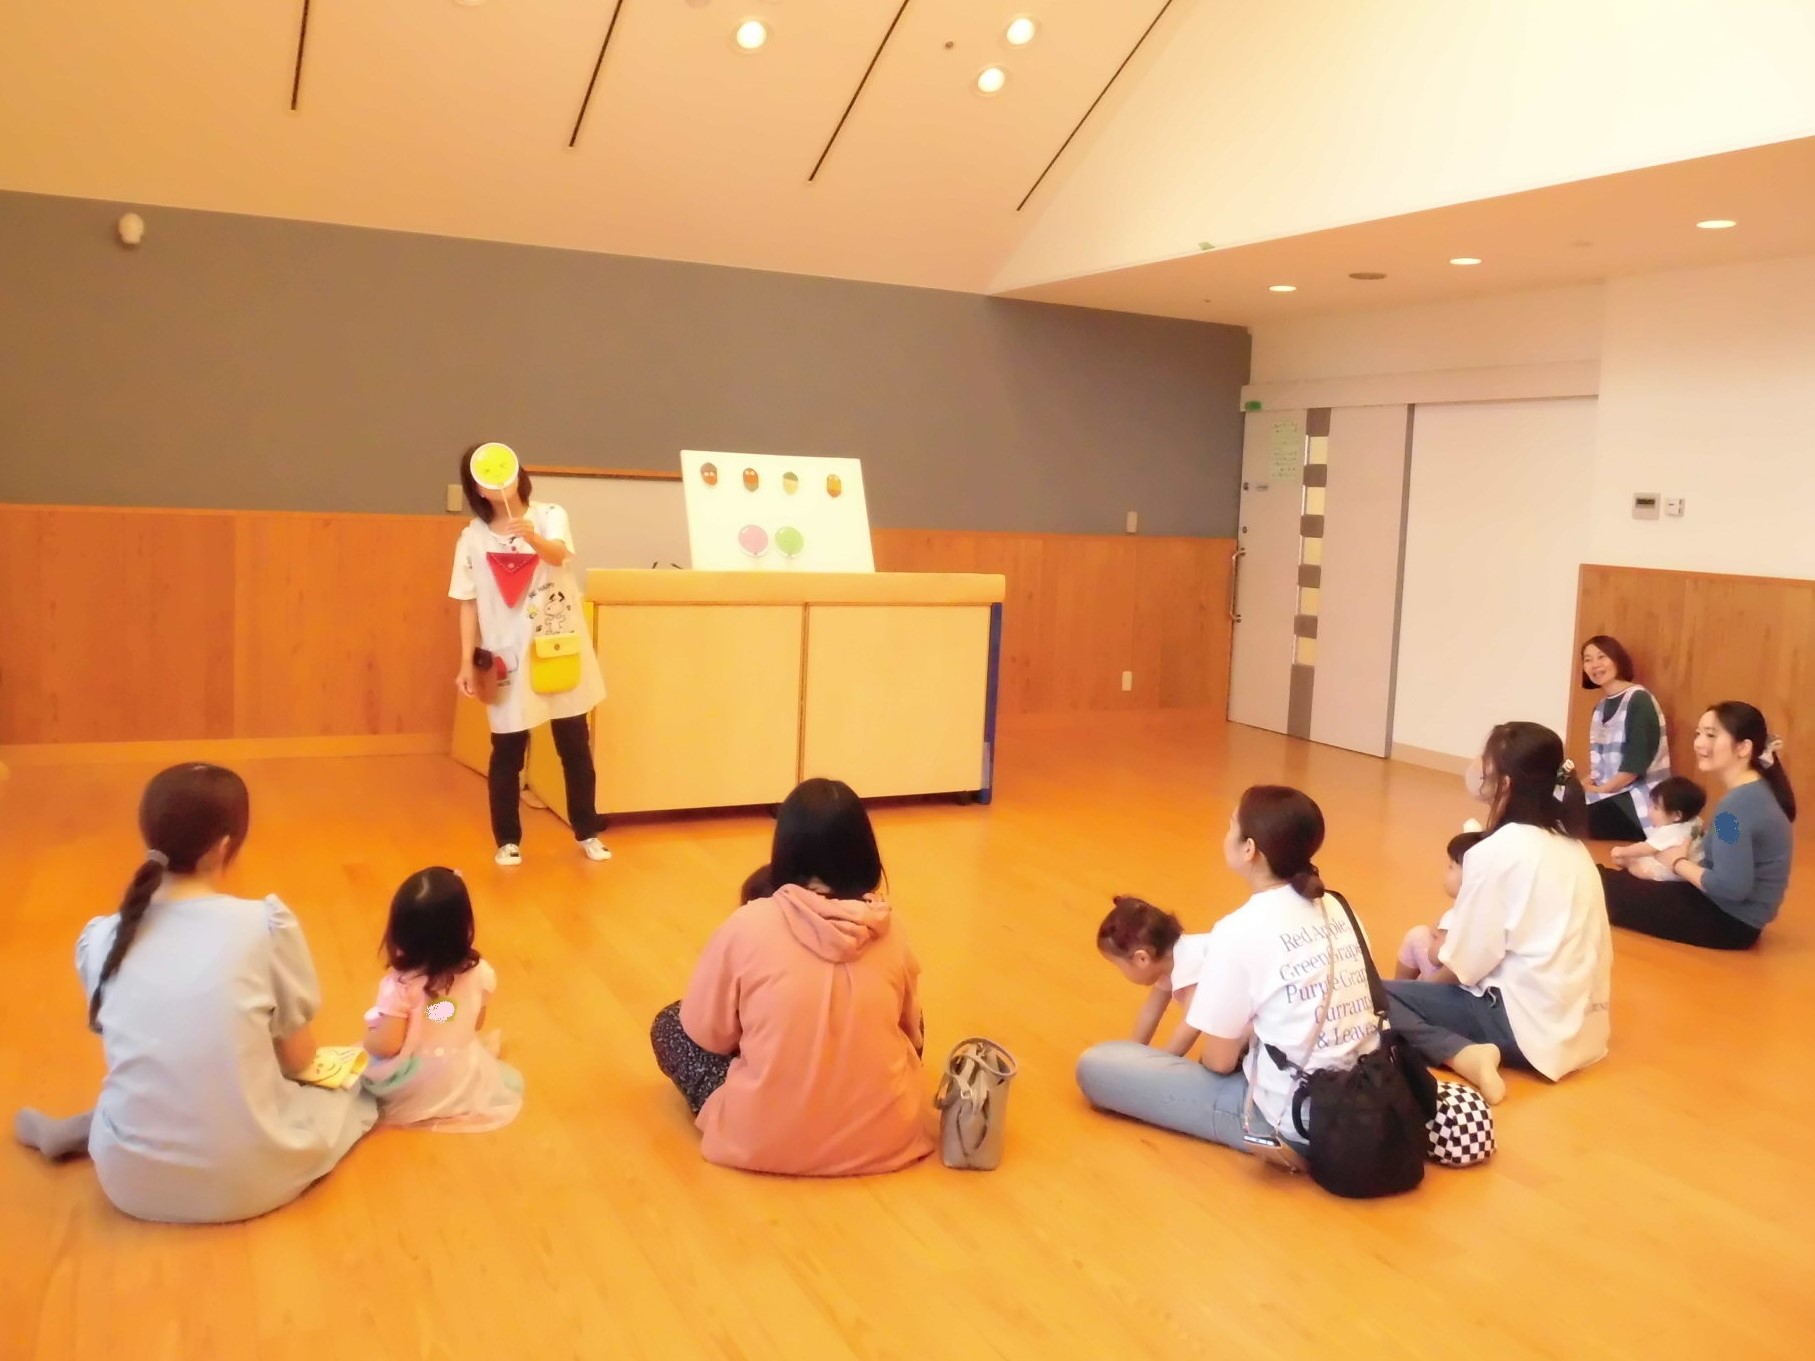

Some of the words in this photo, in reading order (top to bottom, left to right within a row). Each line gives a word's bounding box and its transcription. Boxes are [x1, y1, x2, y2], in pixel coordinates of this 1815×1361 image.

[1280, 926, 1312, 952] Red
[1279, 952, 1327, 981] Green
[1317, 1031, 1329, 1049] &
[1333, 1021, 1378, 1046] Leaves
